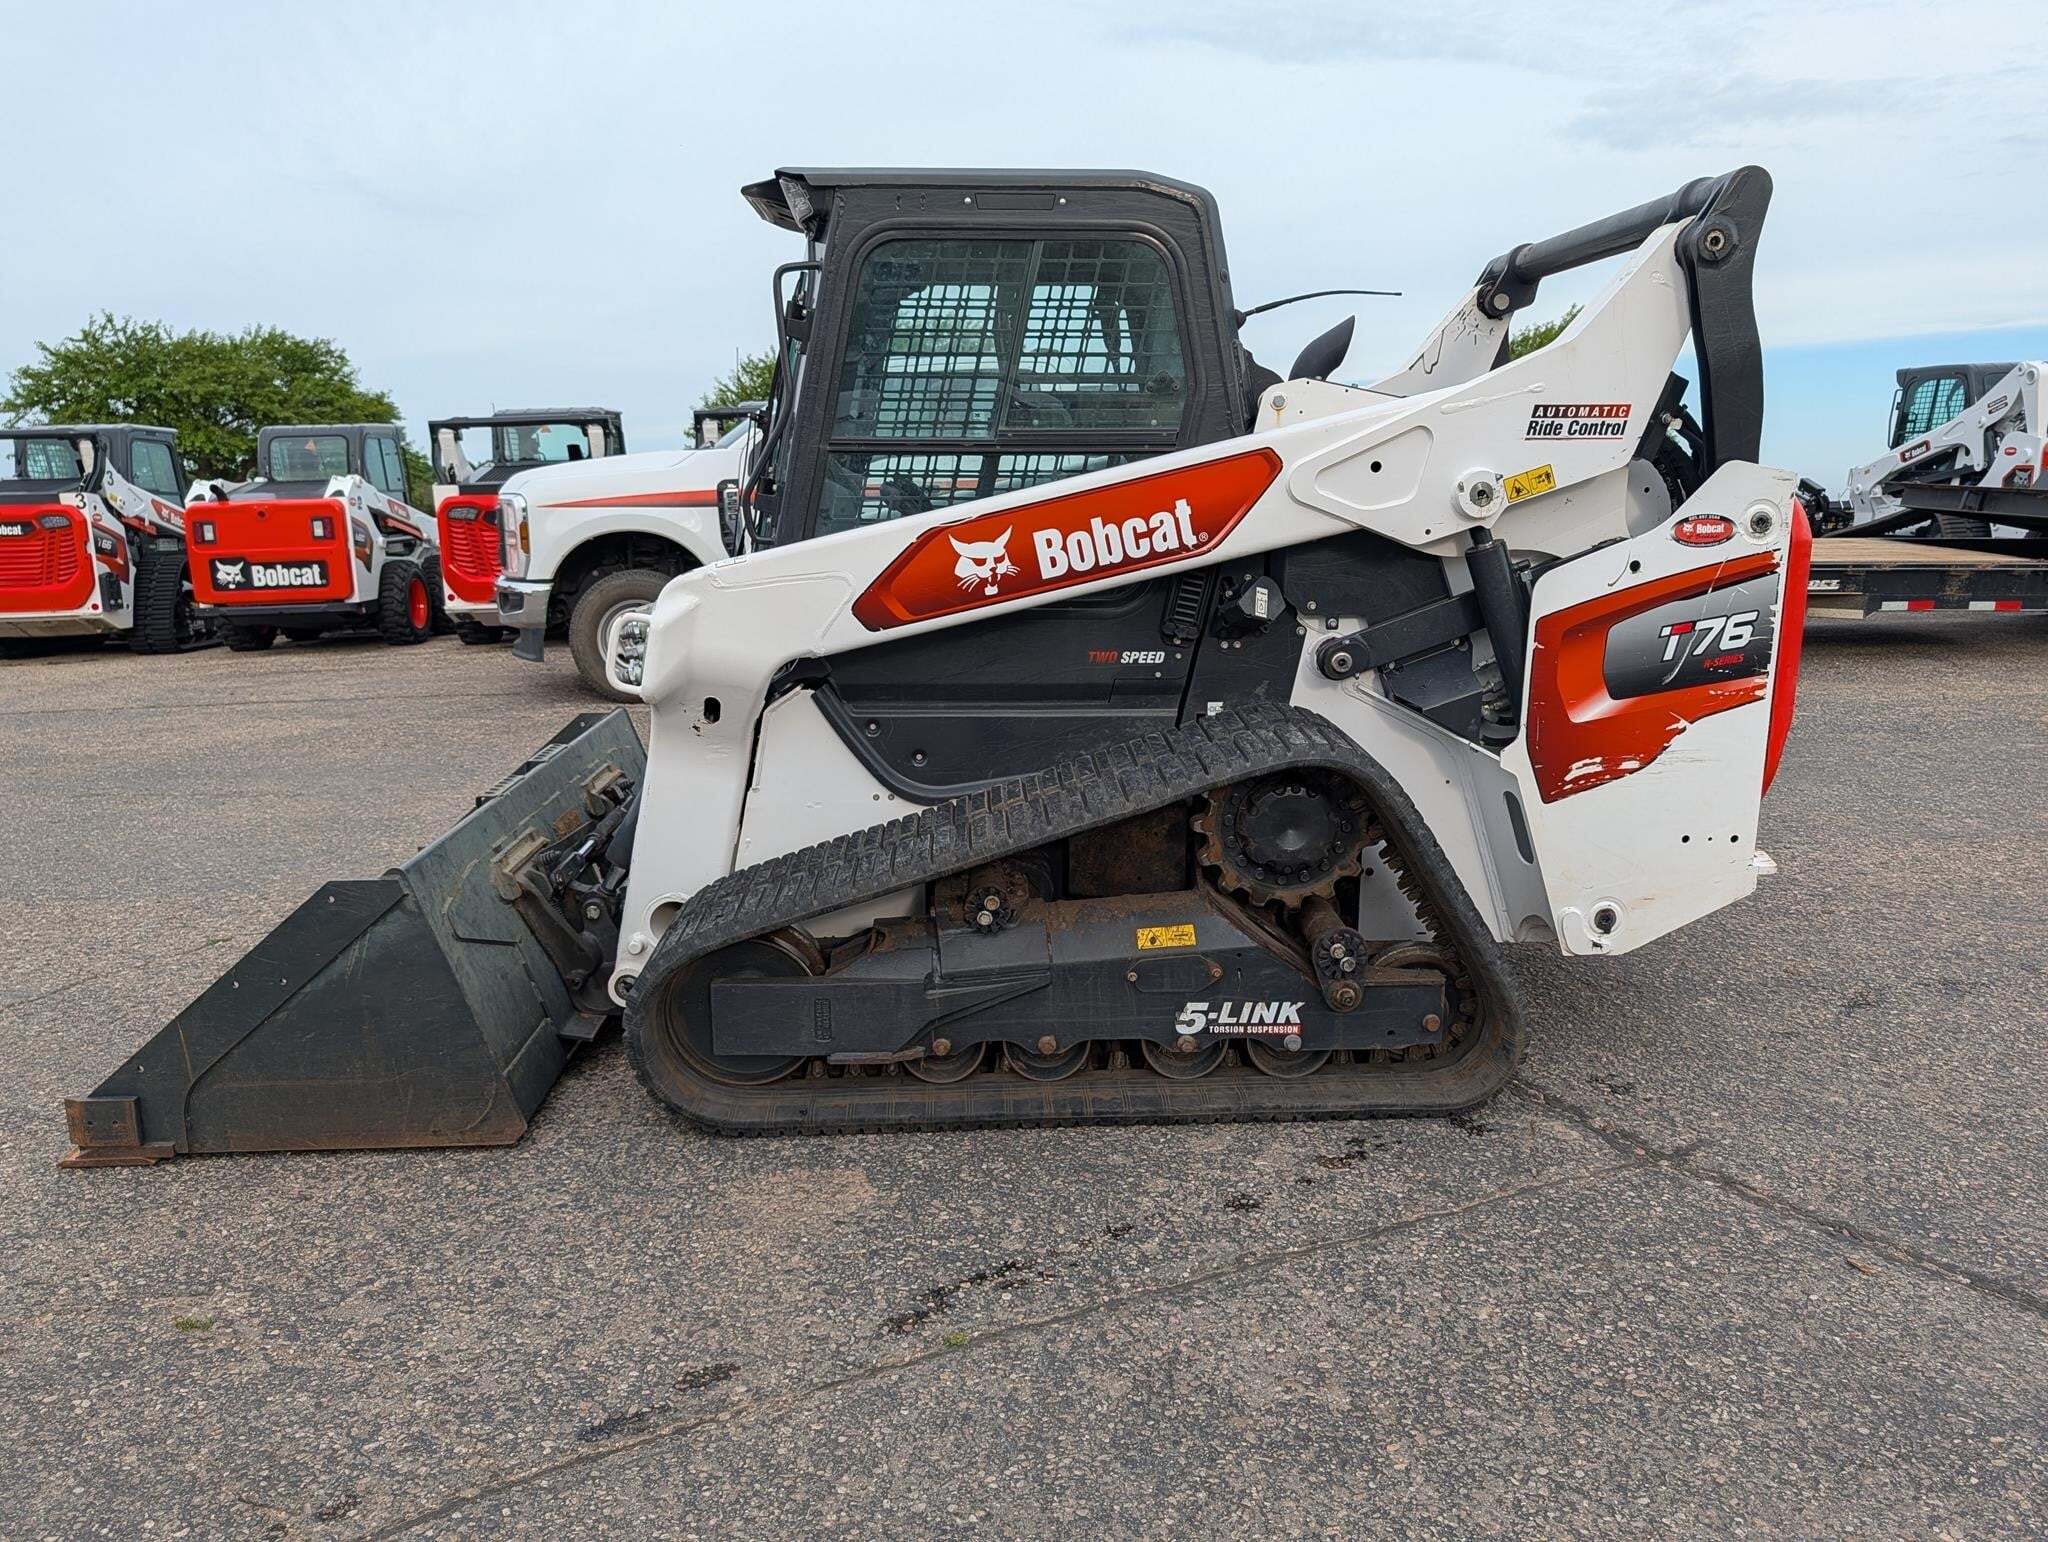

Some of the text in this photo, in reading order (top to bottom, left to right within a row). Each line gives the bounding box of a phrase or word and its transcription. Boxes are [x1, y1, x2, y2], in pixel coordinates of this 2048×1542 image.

[1535, 406, 1628, 417] AUTOMATIC
[1526, 420, 1628, 436] Ride Control
[106, 470, 114, 486] 3
[75, 493, 87, 509] 3
[0, 524, 22, 536] bcat
[1696, 523, 1725, 534] Bobcat
[1032, 498, 1198, 580] Bobcat
[251, 564, 323, 588] Bobcat
[1659, 610, 1760, 662] T76
[1088, 651, 1166, 664] TWO SPEED
[1175, 1001, 1306, 1035] 5-LINK
[1209, 1025, 1299, 1034] TORSION SUSPENSION
